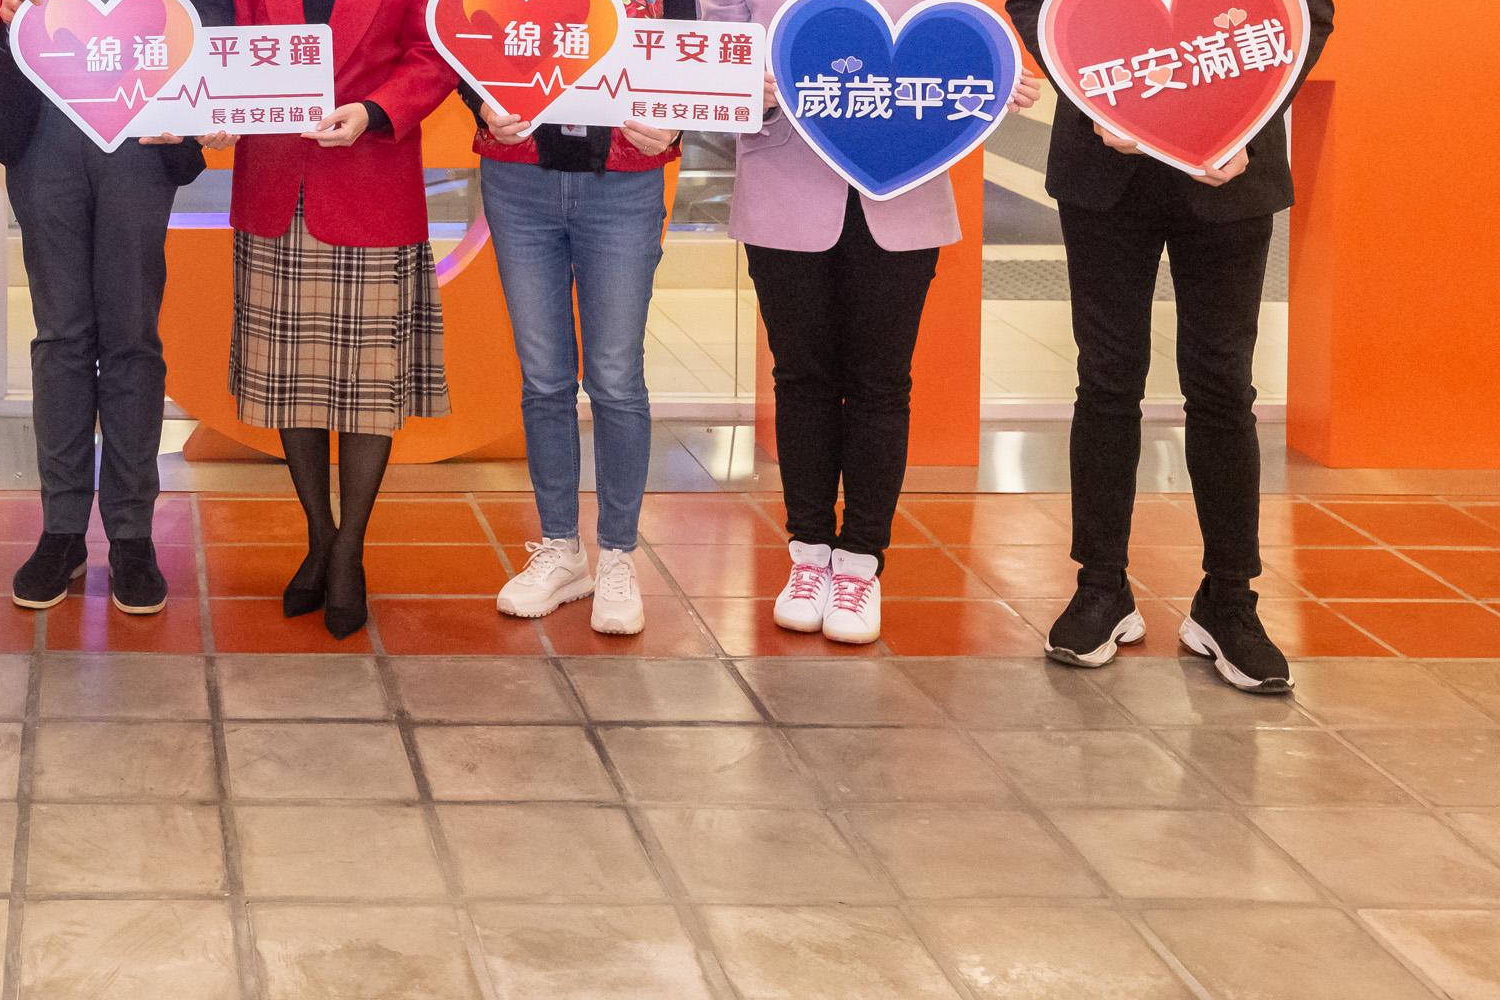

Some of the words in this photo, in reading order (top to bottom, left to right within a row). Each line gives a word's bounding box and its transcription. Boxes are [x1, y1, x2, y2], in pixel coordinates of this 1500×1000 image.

[40, 36, 169, 72] 一線通
[209, 34, 321, 67] 平安鐘
[456, 21, 590, 59] 一線通
[633, 29, 753, 65] 平安鐘
[1078, 17, 1294, 107] 平安滿載
[211, 106, 323, 124] 長者安居協會
[630, 101, 750, 122] 長者安居協會
[794, 73, 996, 122] 歲歲平安
